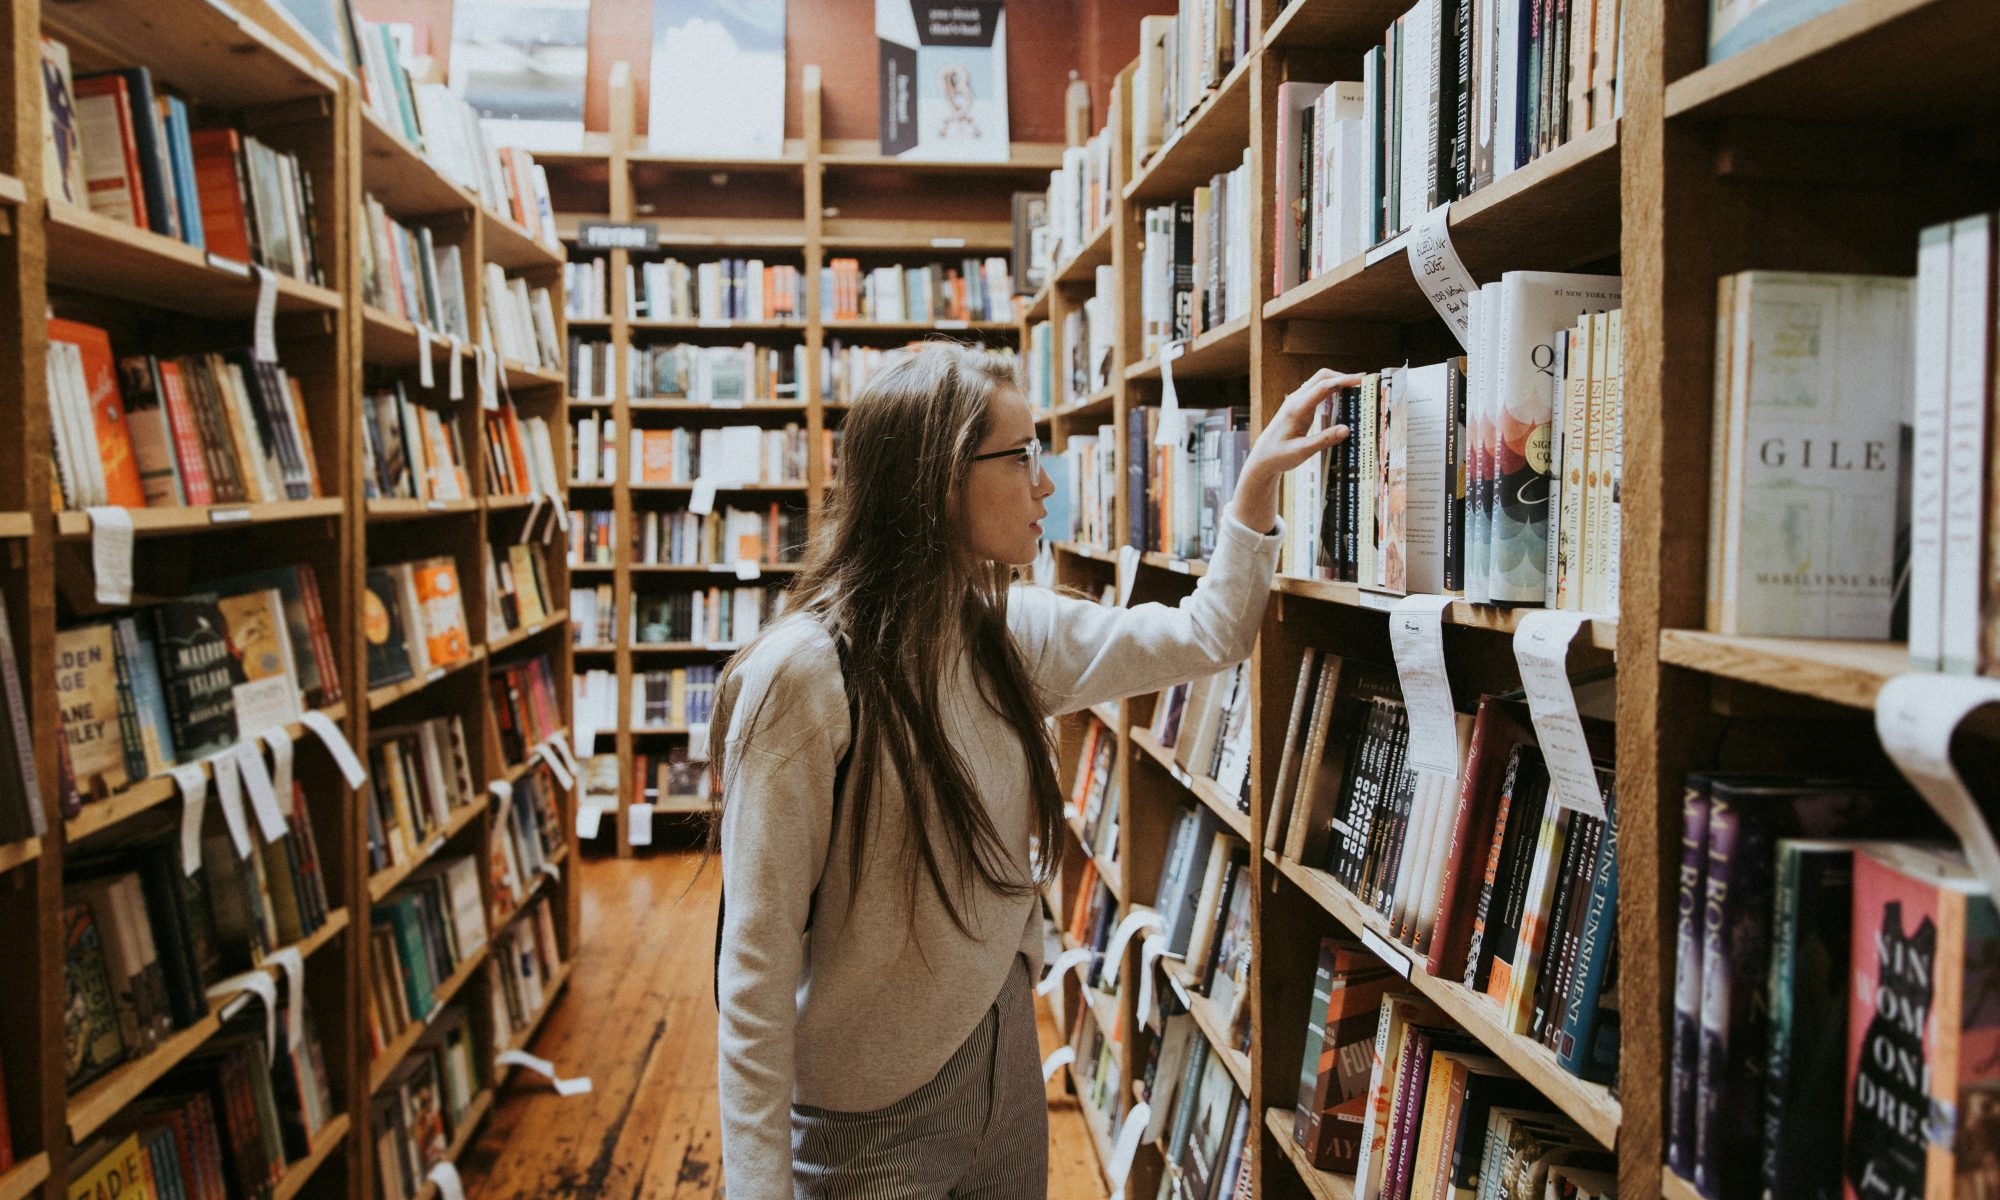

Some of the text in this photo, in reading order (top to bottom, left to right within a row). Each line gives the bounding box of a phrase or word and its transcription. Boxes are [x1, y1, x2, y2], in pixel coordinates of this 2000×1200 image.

[1429, 35, 1439, 93] PYNCHON
[1459, 25, 1468, 84] PYNCHON
[1428, 102, 1438, 161] BLEEDING
[1457, 92, 1467, 152] BLEEDING
[1427, 164, 1436, 194] EDGE
[1456, 155, 1466, 187] EDGE
[1448, 368, 1456, 432] Monument
[1760, 438, 1887, 472] GILE
[1567, 378, 1585, 571] ISHMAEL DANIEL QUINN
[1584, 379, 1601, 575] ISHMAEL DANIEL QUINN
[1599, 377, 1616, 576] ISHMAEL DANIEL QUINN
[1445, 525, 1453, 559] Quimby
[56, 645, 103, 670] DEN
[187, 667, 231, 698] ISLAND
[1383, 745, 1398, 807] IMPERFECTIONISTS
[1388, 748, 1404, 810] IMPERFECTIONISTS
[1463, 746, 1479, 781] Devil
[1349, 779, 1371, 856] OTARED
[1357, 782, 1378, 861] OTARED
[1447, 796, 1467, 859] Jerusalem
[1566, 831, 1577, 867] RAKHA
[1437, 870, 1451, 904] NAOMI
[1586, 857, 1594, 882] CAME
[1504, 891, 1513, 924] Childhood
[1511, 896, 1522, 928] Childhood
[1545, 908, 1562, 976] CROCODILES
[1568, 892, 1606, 1026] PUNISHMENT
[1392, 1050, 1409, 1127] UNRESTORED
[1432, 1059, 1441, 1088] KNOW
[1441, 1071, 1450, 1100] KNOW
[1396, 1060, 1420, 1183] UNRESTORED WOMAN
[1427, 1090, 1436, 1117] YOUR
[1435, 1101, 1446, 1131] YOUR
[1445, 1117, 1453, 1140] RON
[1386, 1126, 1397, 1171] WOMAN
[1439, 1142, 1448, 1172] RASH
[1503, 1147, 1517, 1184] THE
